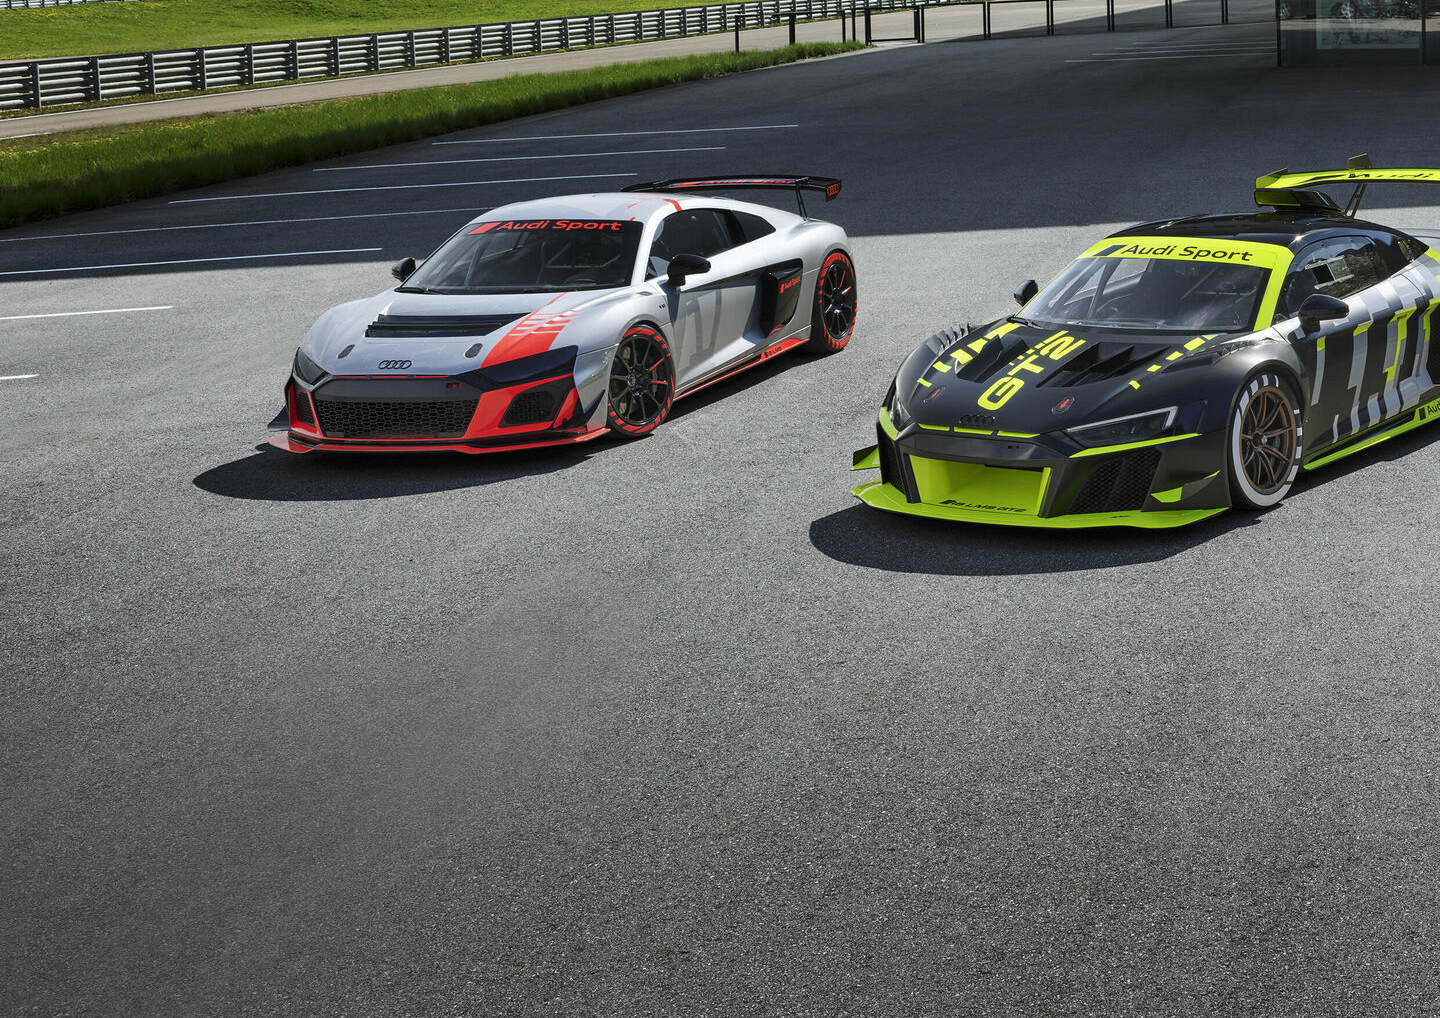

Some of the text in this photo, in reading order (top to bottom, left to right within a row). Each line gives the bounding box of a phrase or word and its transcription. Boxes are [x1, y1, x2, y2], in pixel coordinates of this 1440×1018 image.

[496, 220, 622, 231] Audi Sport
[1121, 244, 1253, 262] Audi Sport
[977, 336, 1087, 411] GT2
